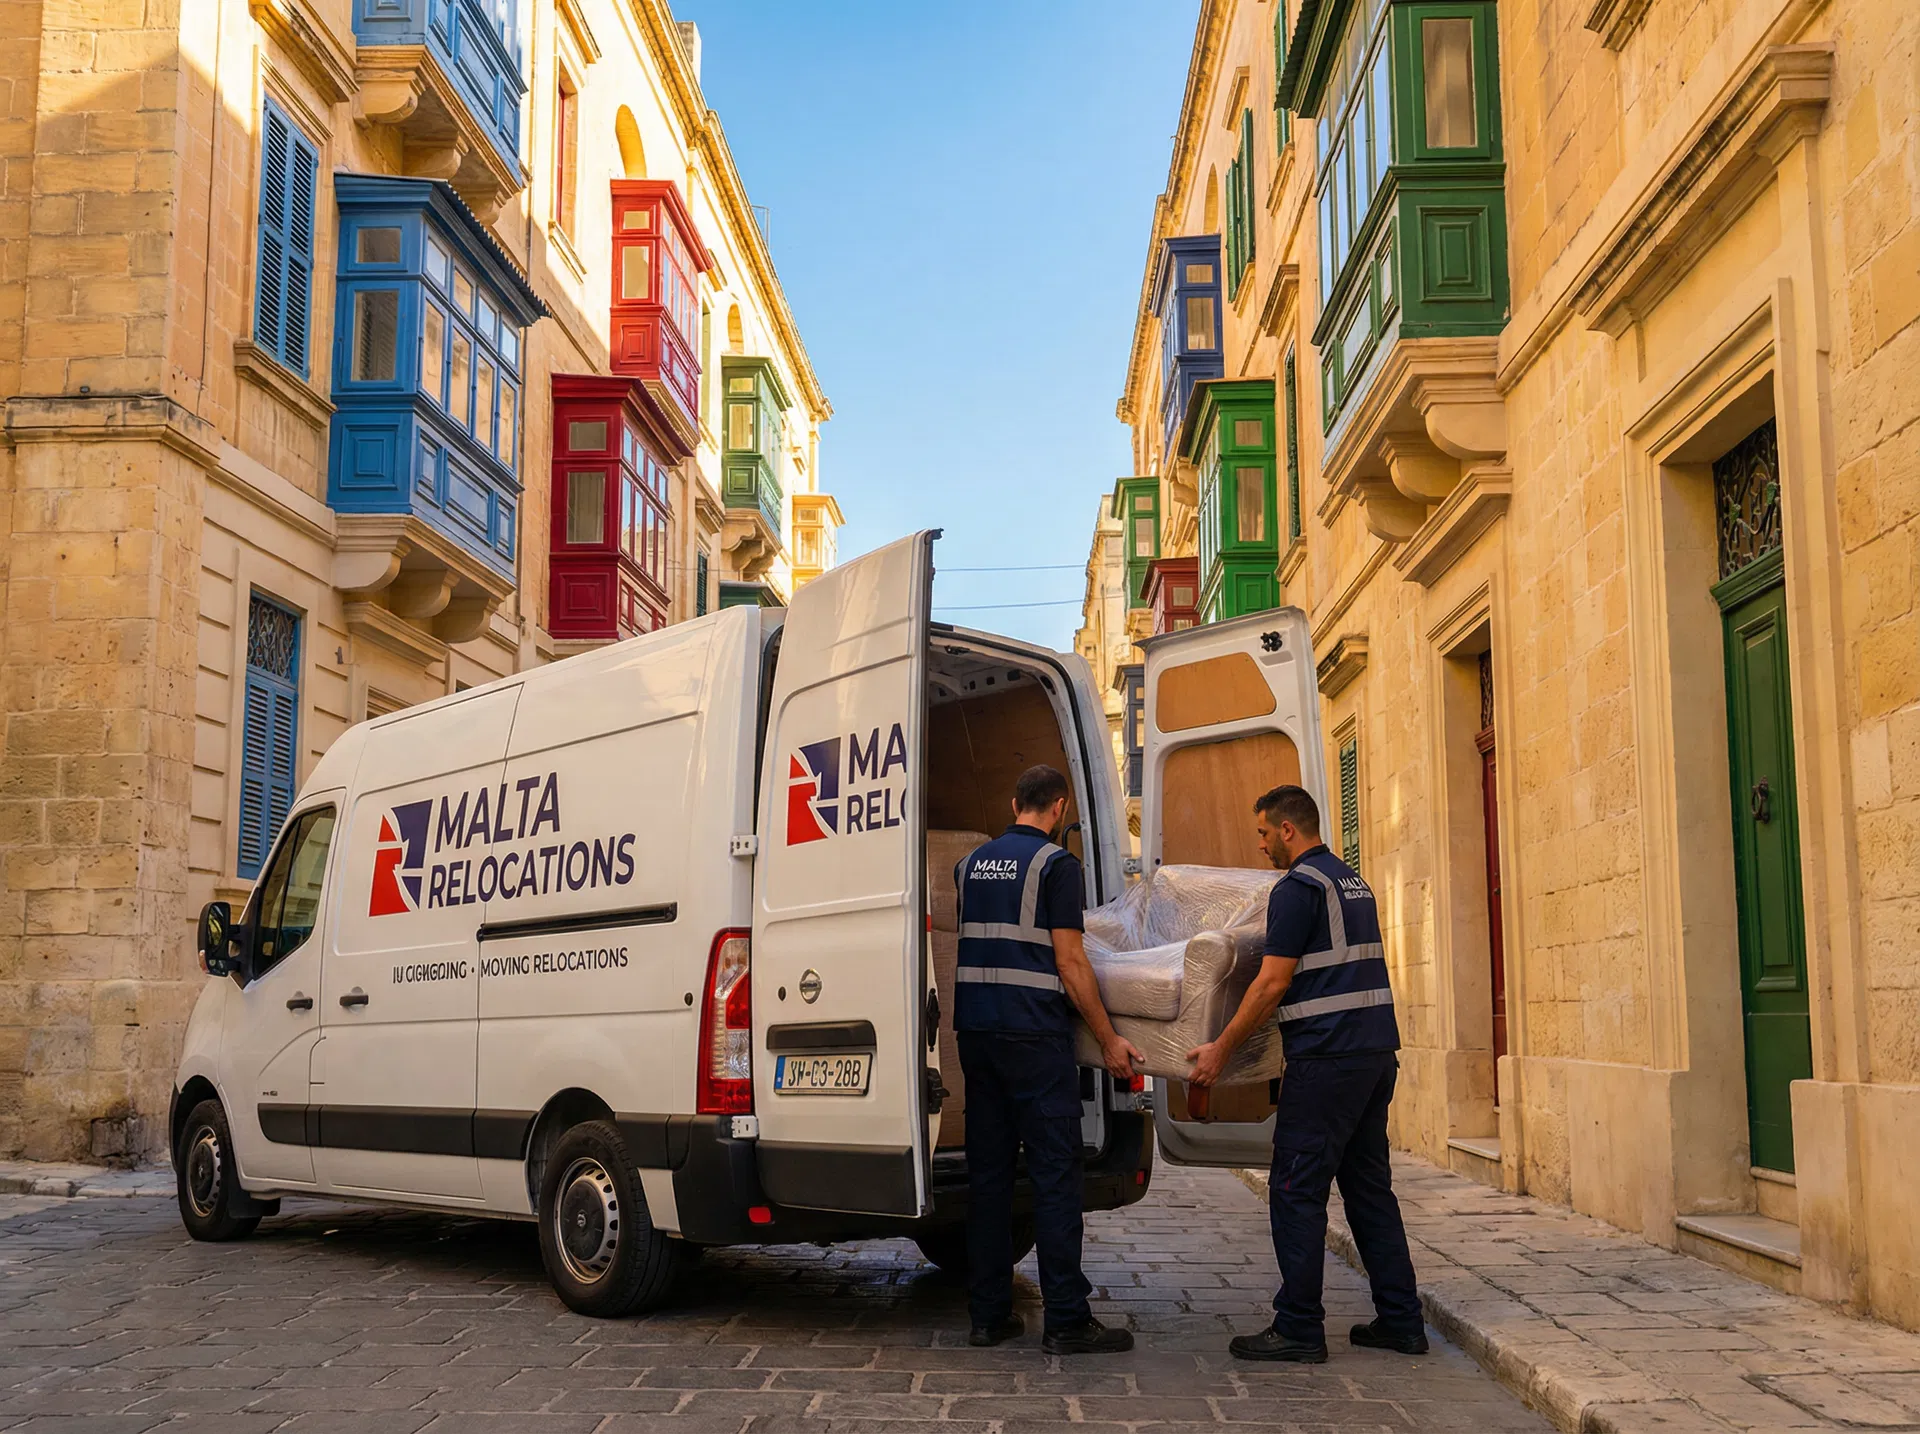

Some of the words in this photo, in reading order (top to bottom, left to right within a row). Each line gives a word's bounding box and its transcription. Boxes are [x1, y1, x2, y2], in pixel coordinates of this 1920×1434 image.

[435, 772, 560, 853] MALTA
[428, 833, 636, 909] RELOCATIONS
[974, 859, 1018, 871] MALTA
[481, 955, 530, 978] MOVING
[534, 947, 628, 974] RELOCATIONS
